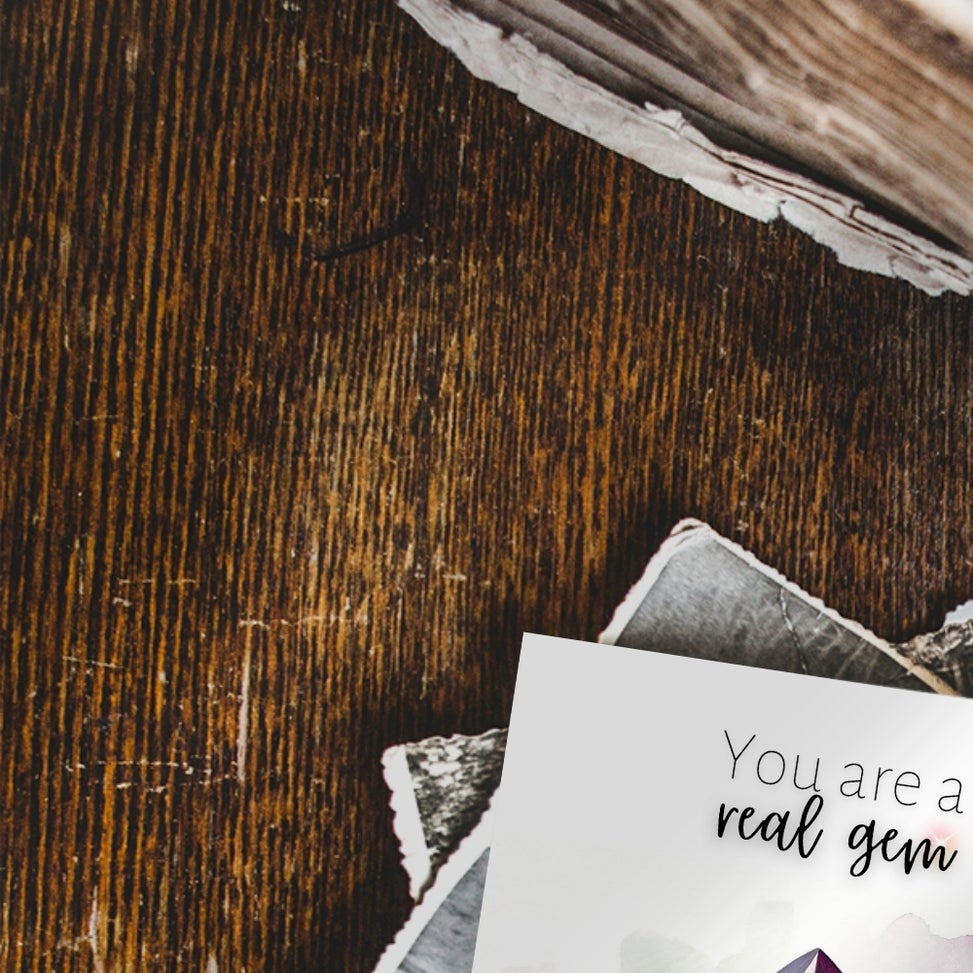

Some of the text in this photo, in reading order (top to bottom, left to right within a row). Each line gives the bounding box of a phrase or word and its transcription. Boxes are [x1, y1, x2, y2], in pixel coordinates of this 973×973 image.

[724, 729, 964, 814] You are a
[717, 794, 958, 877] real gem
